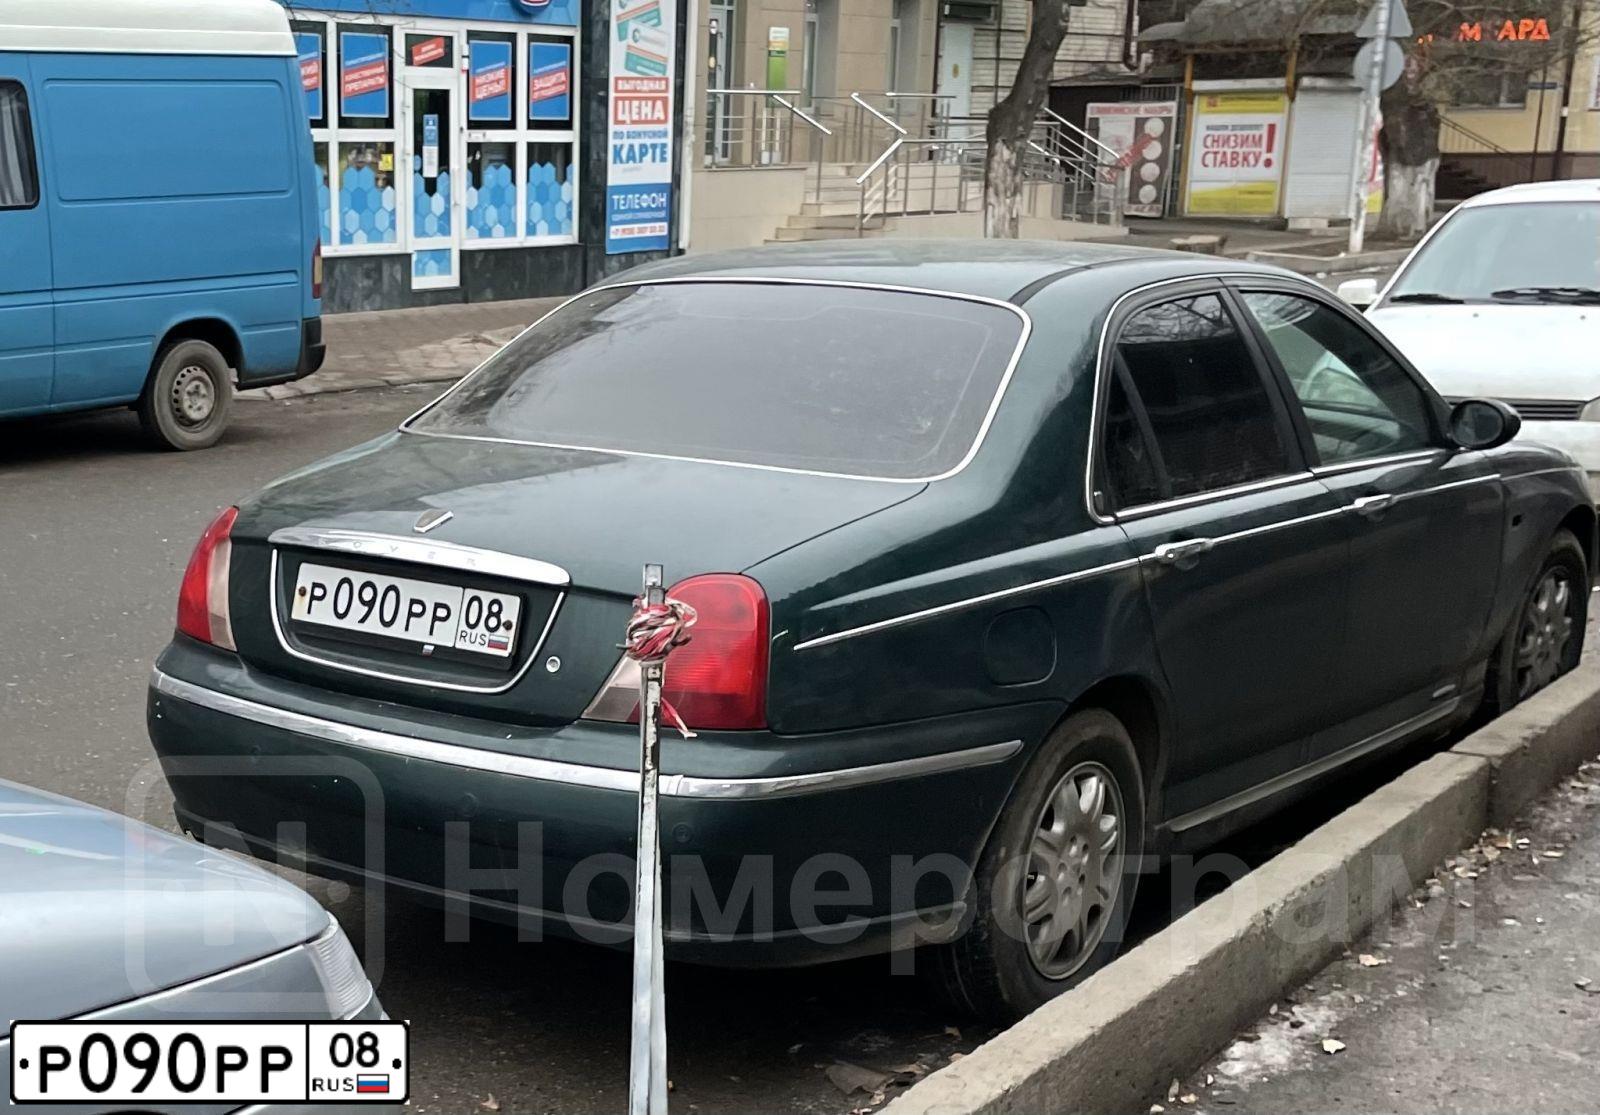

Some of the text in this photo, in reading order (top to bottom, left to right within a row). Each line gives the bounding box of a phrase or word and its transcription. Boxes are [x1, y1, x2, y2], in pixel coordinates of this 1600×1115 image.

[616, 79, 667, 92] ВЫГОДНАЯ
[616, 99, 667, 124] ЦЕНА
[612, 128, 668, 140] ПО БОНУСНОЙ
[1202, 133, 1263, 150] СНИЗИМ
[612, 143, 668, 165] КАРТЕ
[1201, 150, 1262, 168] СТАВКУ
[611, 192, 667, 211] ТЕЛЕФОН
[307, 576, 503, 636] Р090РР 08
[458, 630, 487, 646] RUS
